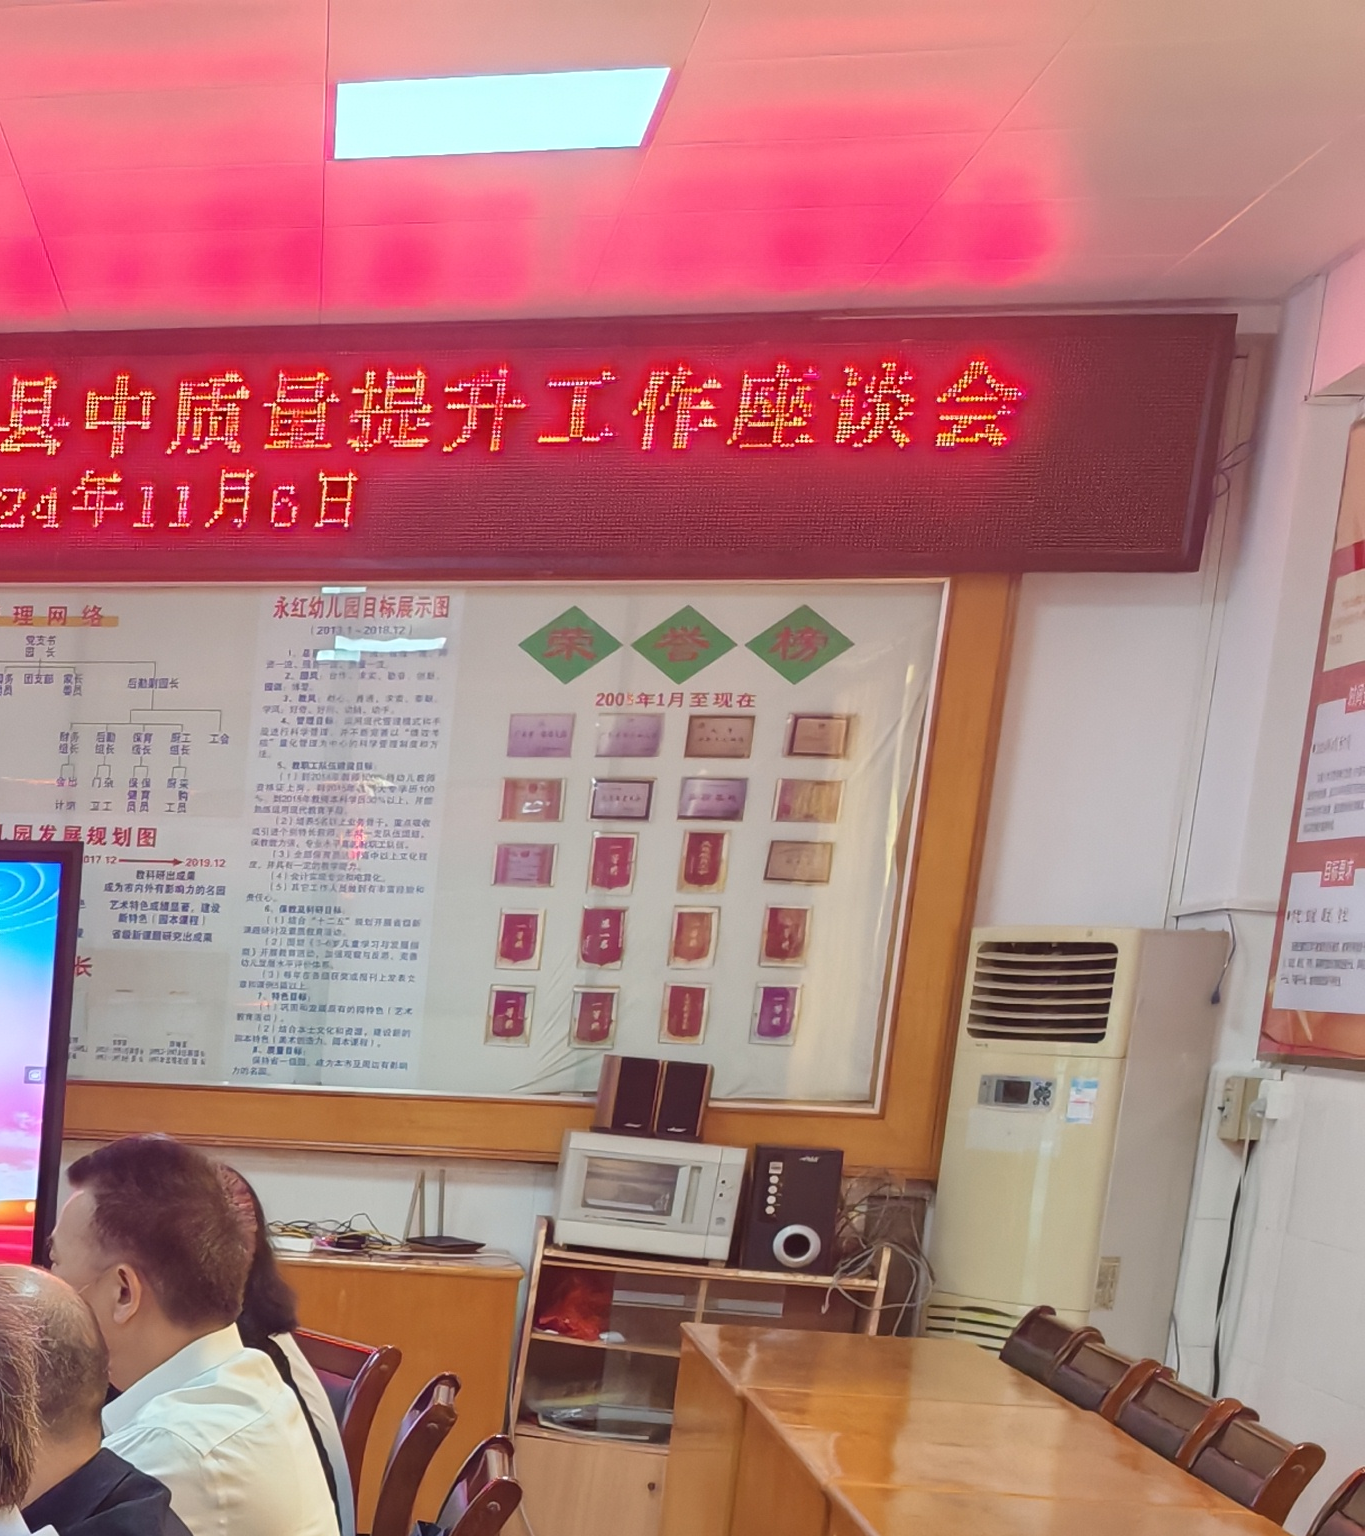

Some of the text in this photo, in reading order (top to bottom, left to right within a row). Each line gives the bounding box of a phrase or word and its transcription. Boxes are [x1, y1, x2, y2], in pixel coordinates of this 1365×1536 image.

[272, 595, 450, 619] 永红幼儿园目标展示图
[542, 626, 829, 663] 荣誉榜
